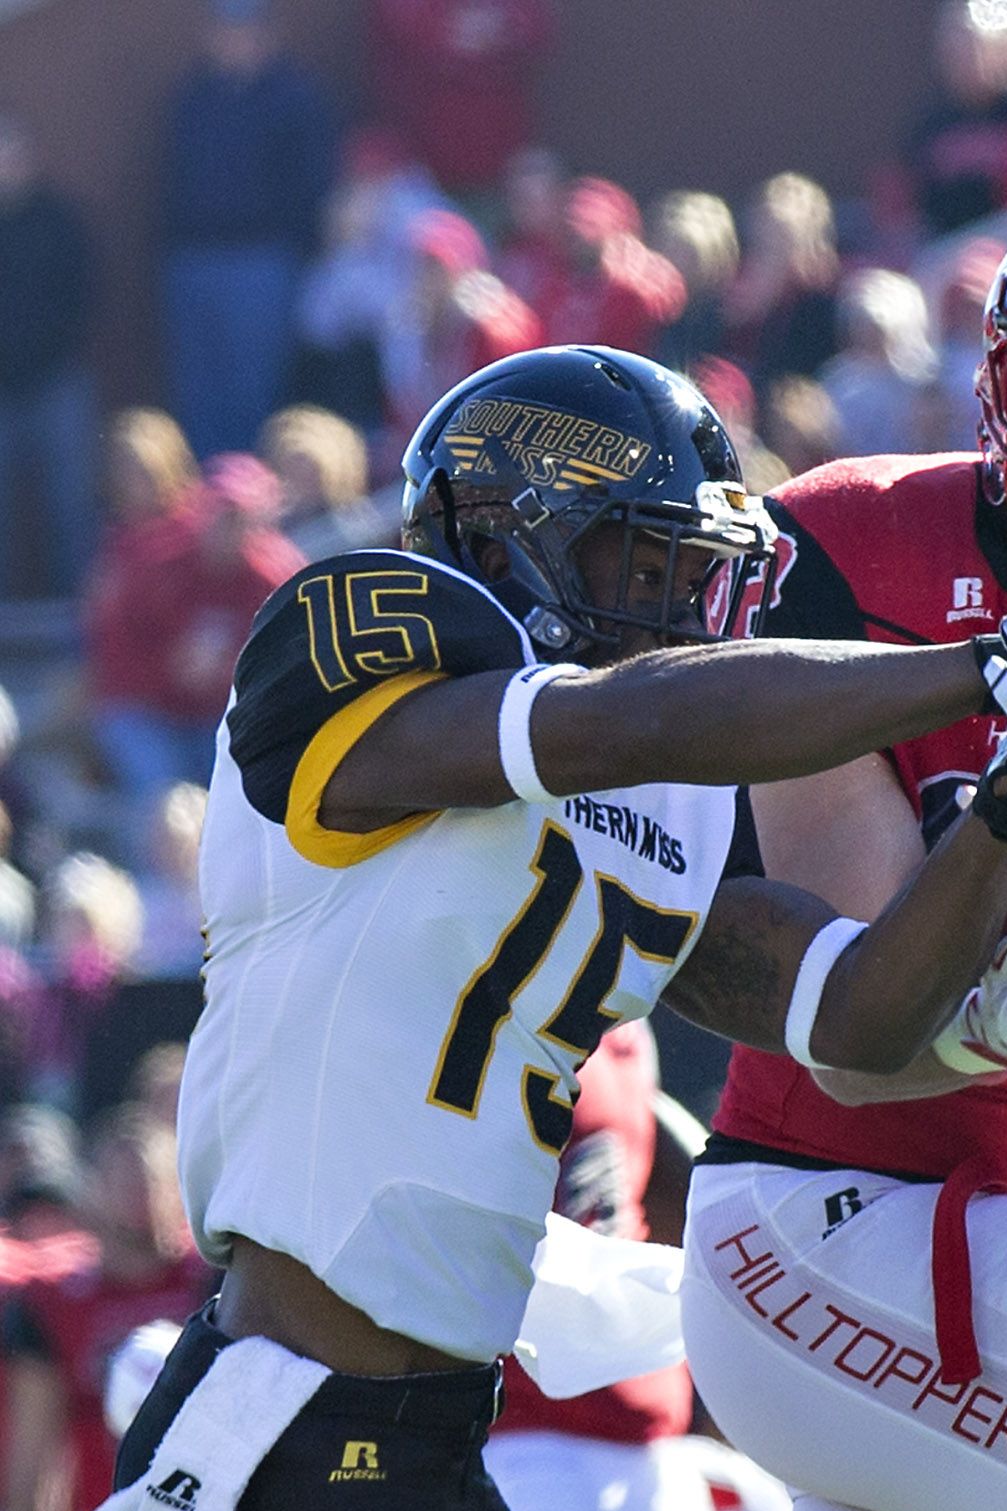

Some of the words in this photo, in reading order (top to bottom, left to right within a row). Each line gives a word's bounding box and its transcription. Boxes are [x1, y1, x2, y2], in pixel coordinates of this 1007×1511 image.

[446, 399, 652, 477] SOUTHERN
[297, 570, 442, 692] 15
[953, 577, 983, 608] R
[426, 817, 700, 1157] 15
[341, 1440, 379, 1469] R
